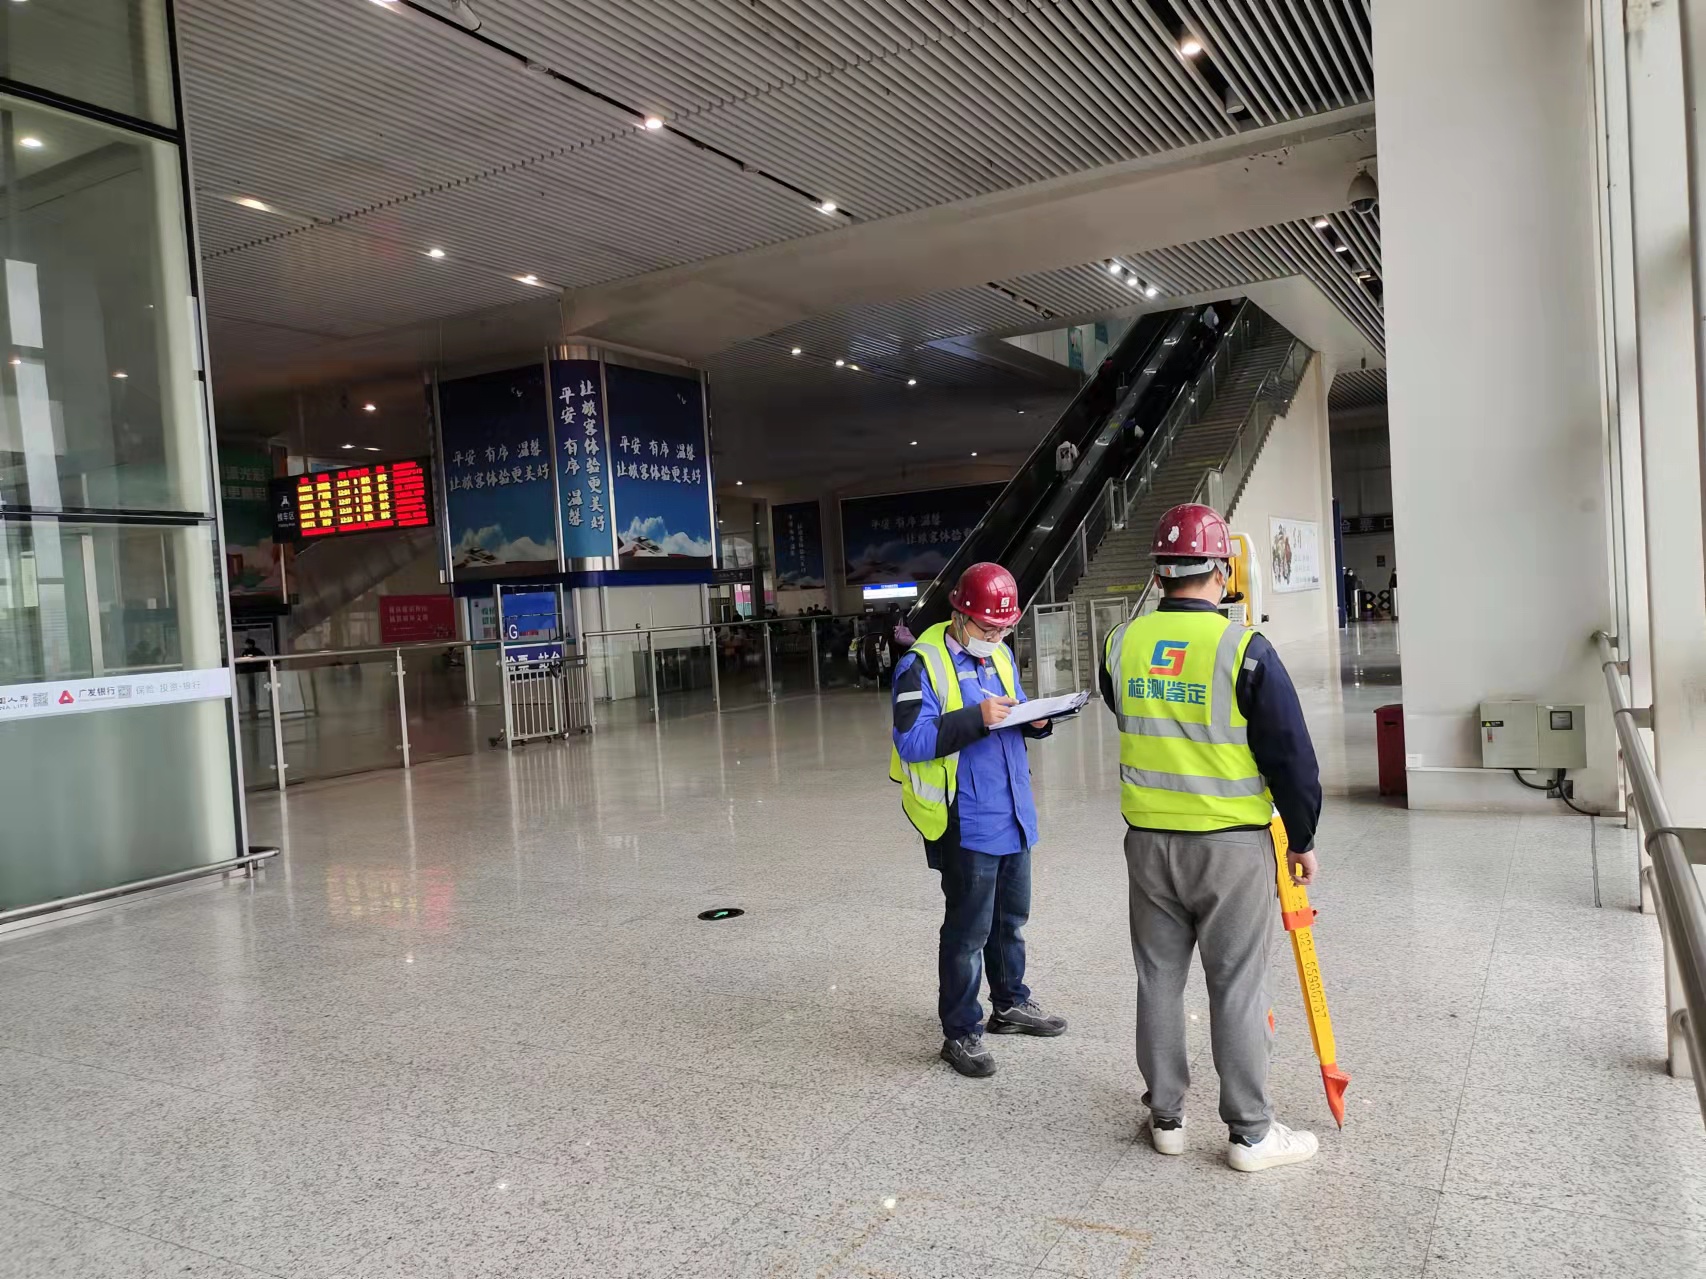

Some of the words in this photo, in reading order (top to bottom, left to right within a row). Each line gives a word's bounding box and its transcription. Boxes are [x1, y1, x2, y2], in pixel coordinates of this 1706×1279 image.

[559, 386, 577, 425] 平安
[453, 449, 477, 468] 平安
[484, 443, 510, 463] 有序
[563, 437, 581, 476] 有序
[580, 380, 606, 532] 让旅客体验更美好
[619, 435, 642, 456] 平安
[648, 440, 670, 459] 有序
[449, 463, 550, 492] 让旅客体验更美好
[616, 460, 701, 485] 让旅客体验更美好
[566, 488, 584, 526] 温馨
[508, 624, 518, 640] G
[79, 687, 115, 698] 广发银行
[1128, 677, 1207, 706] 检测鉴定
